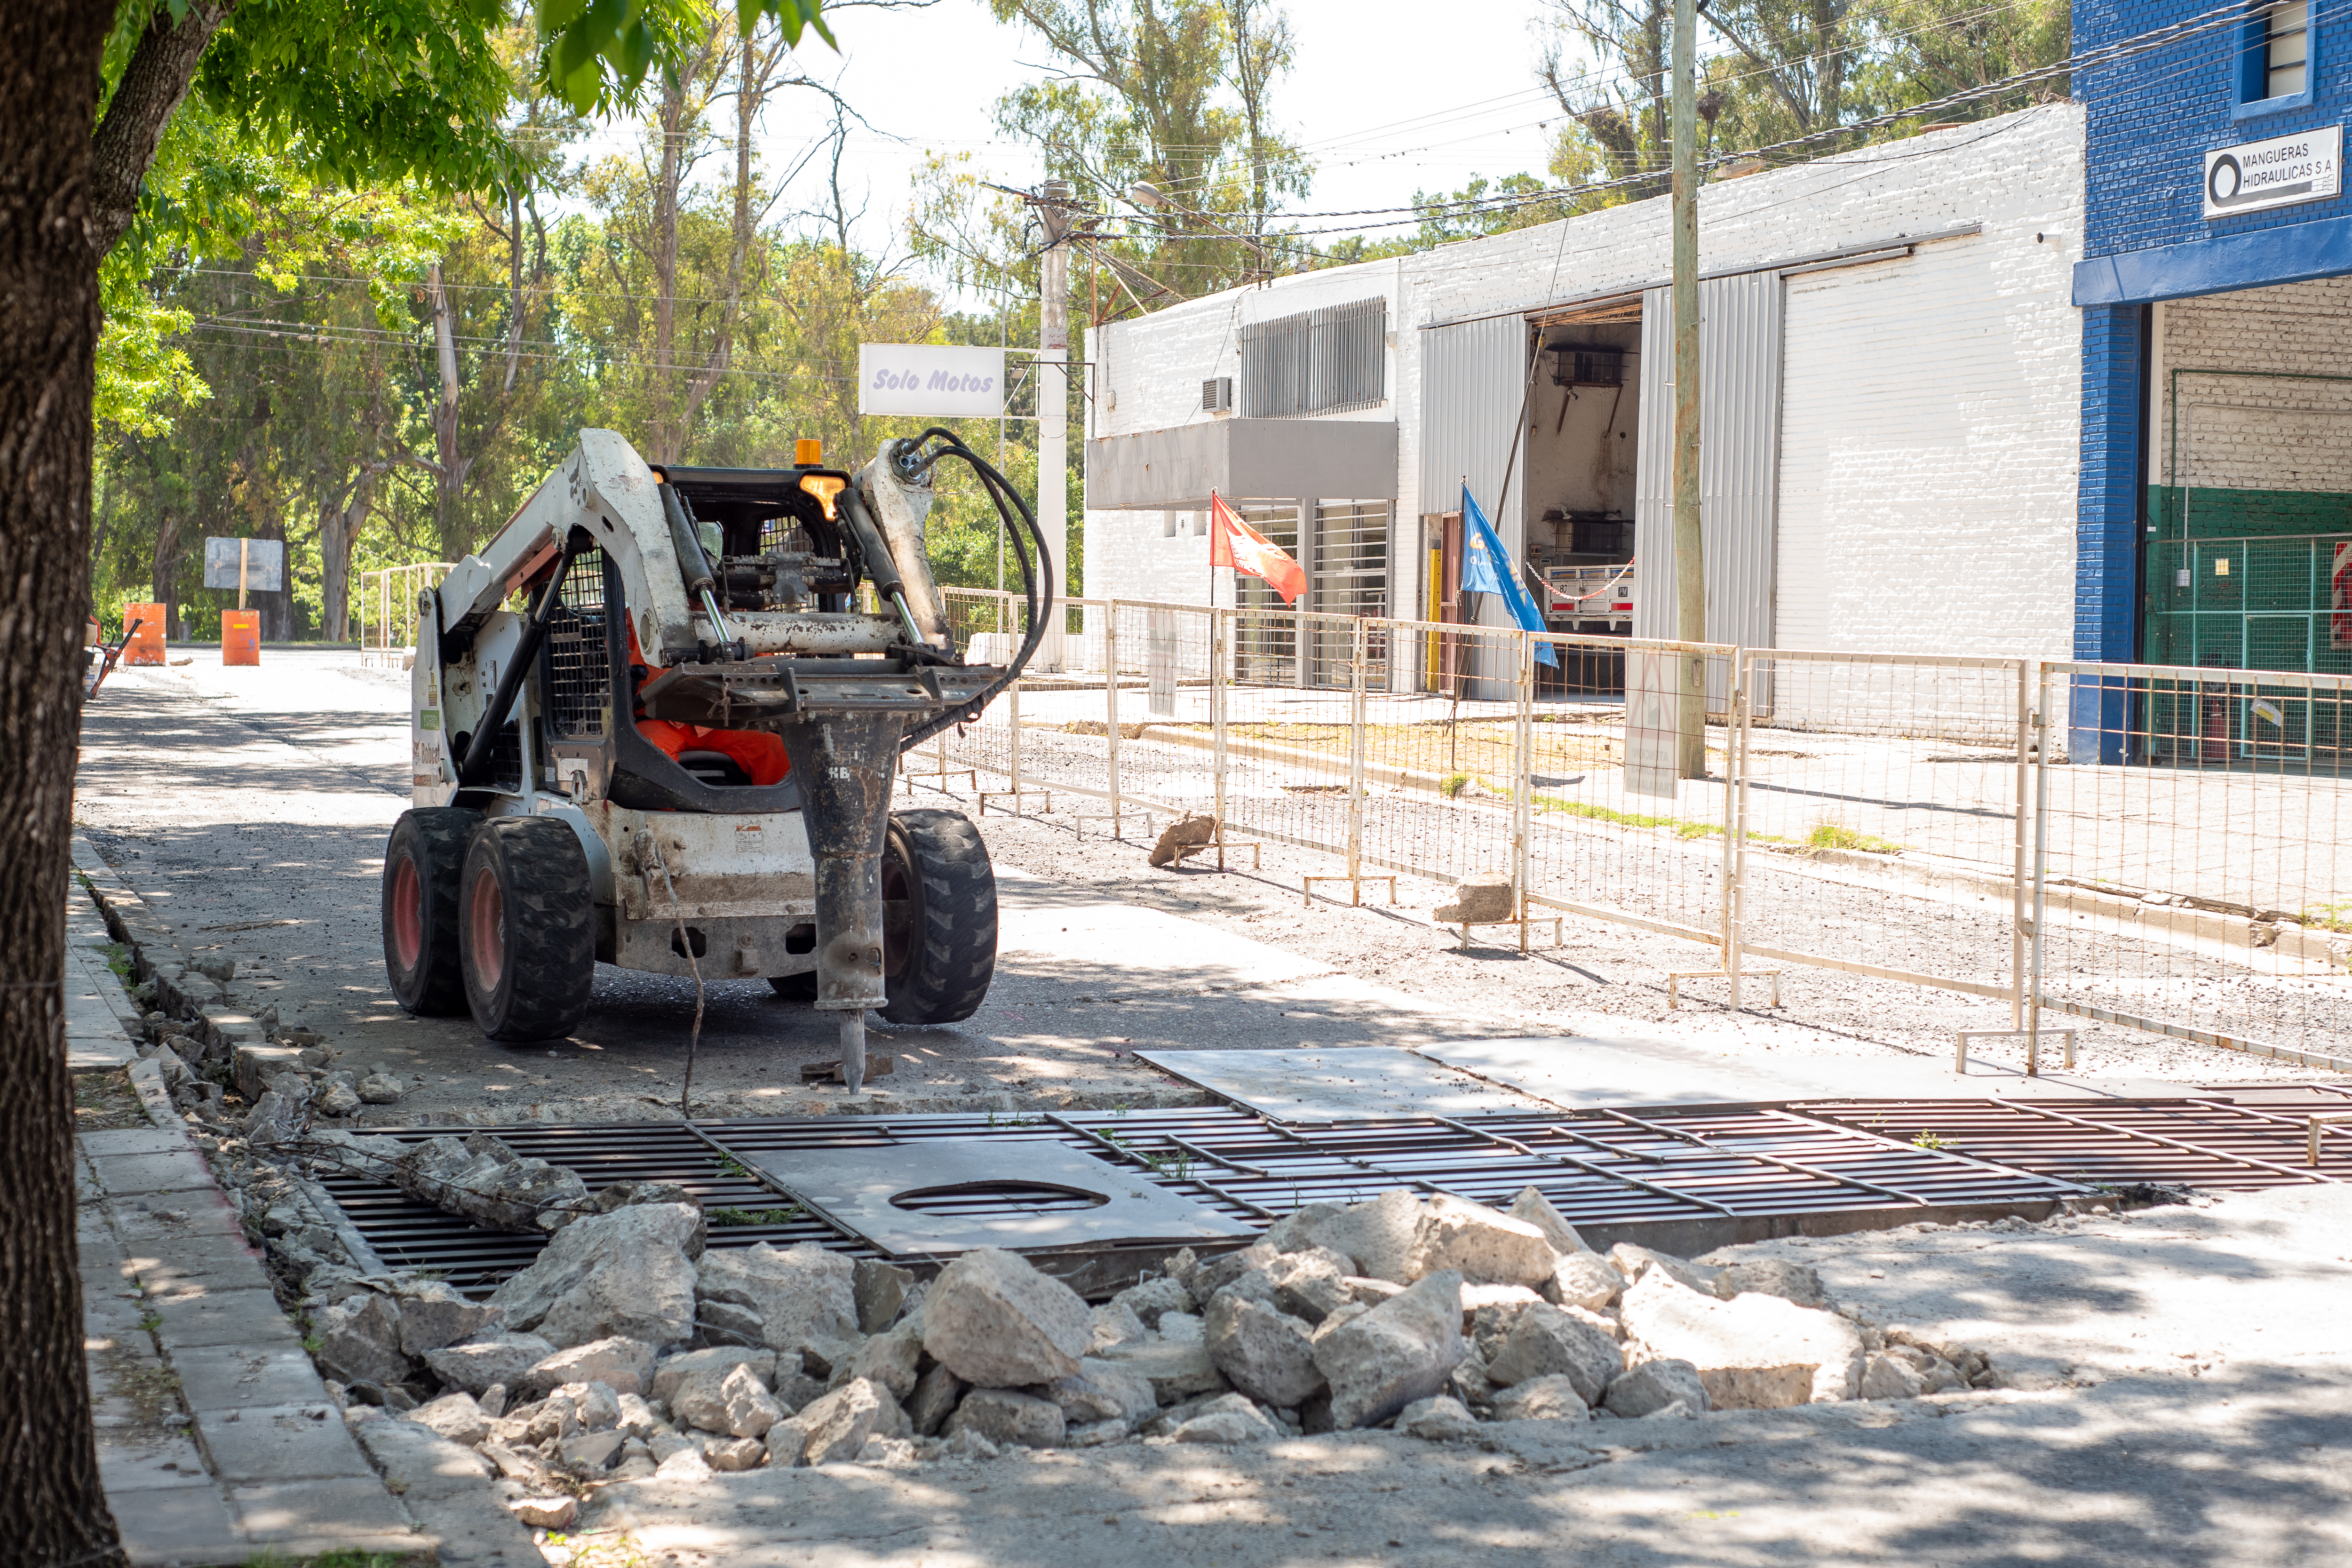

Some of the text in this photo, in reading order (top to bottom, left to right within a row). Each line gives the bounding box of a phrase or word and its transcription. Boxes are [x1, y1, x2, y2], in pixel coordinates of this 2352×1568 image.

[2243, 143, 2309, 168] MANGUERAS
[2243, 163, 2312, 188] HIDRAULICAS
[873, 368, 993, 393] Solo Motos
[1560, 584, 1567, 593] 80
